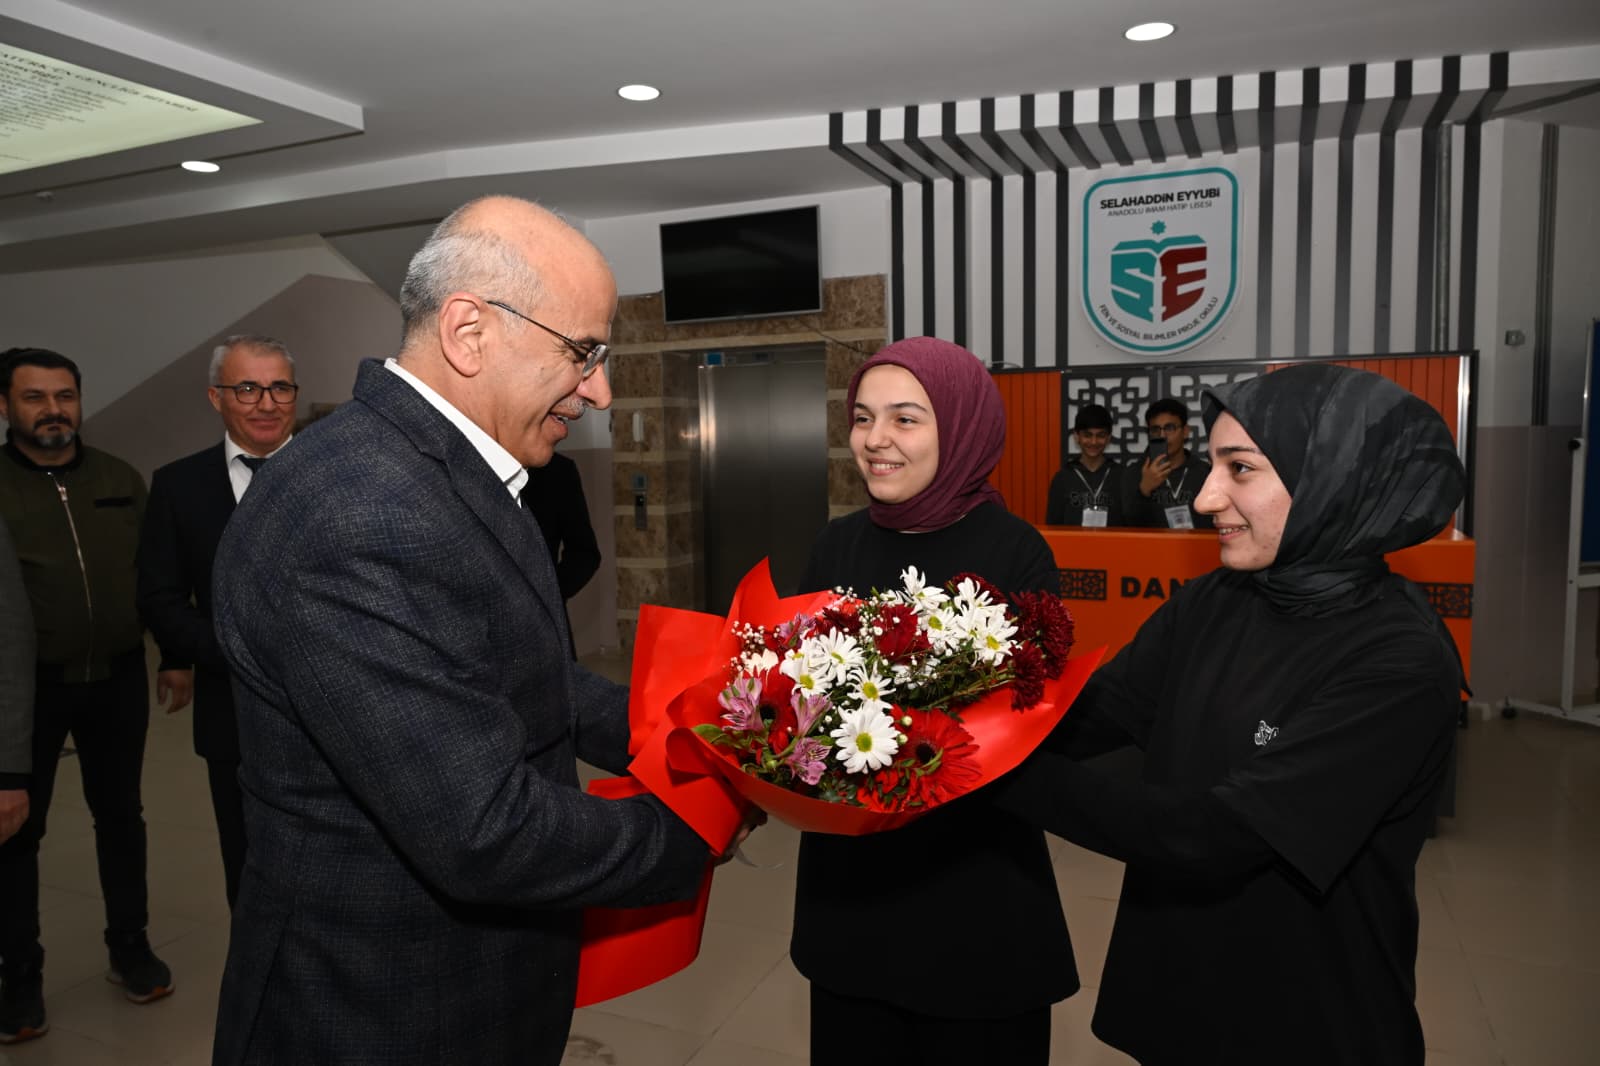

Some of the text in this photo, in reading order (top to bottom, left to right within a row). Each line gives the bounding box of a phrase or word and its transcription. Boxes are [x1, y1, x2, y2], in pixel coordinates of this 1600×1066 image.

[1107, 207, 1144, 217] ANADOLU
[1099, 304, 1109, 318] FEN
[1108, 317, 1117, 326] VE
[1116, 323, 1140, 339] SOSYAL
[1178, 318, 1201, 335] PROJE
[1199, 296, 1219, 319] OKULU
